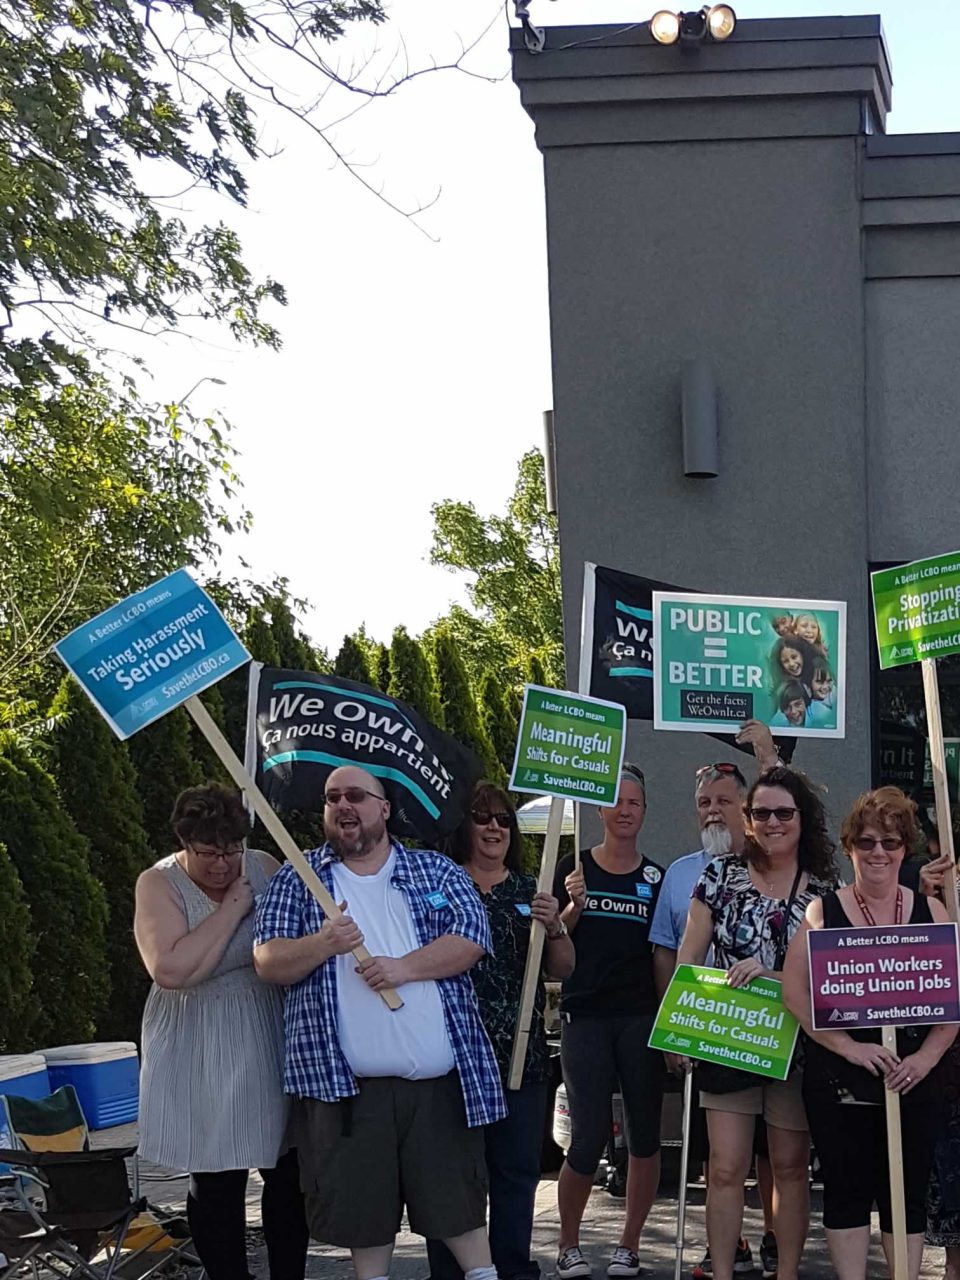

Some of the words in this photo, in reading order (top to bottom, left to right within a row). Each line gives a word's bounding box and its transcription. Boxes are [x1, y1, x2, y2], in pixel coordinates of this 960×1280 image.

[895, 577, 900, 585] A
[901, 572, 919, 584] Better
[920, 566, 940, 578] LCBO
[89, 633, 97, 644] A
[96, 619, 123, 638] Better
[122, 603, 146, 623] LCBO
[147, 590, 172, 609] means
[670, 608, 762, 636] PUBLIC
[87, 650, 136, 682] Taking
[132, 602, 208, 655] Harassment
[616, 617, 653, 650] W
[116, 626, 207, 691] Seriously
[612, 642, 634, 660] Ça
[162, 652, 230, 698] SavetheLCBO.ca
[669, 662, 763, 688] BETTER
[686, 692, 704, 704] Get
[706, 694, 721, 705] the
[724, 694, 747, 707] facts:
[688, 705, 746, 718] WeOwnIt.ca
[269, 694, 324, 723] We
[334, 702, 424, 753] Own
[564, 706, 584, 717] LCBO
[585, 712, 605, 722] means
[530, 722, 612, 754] Meaningful
[262, 729, 281, 752] Ça
[286, 723, 337, 740] nous
[341, 727, 451, 799] appartient
[527, 746, 547, 762] Shifts
[550, 750, 569, 766] for
[571, 755, 610, 774] Casuals
[543, 773, 605, 794] SavetheLCBO.ca
[601, 899, 635, 913] Own
[639, 905, 648, 917] It
[838, 938, 845, 946] A
[847, 937, 873, 946] Better
[876, 936, 899, 944] LCBO
[827, 960, 875, 976] Union
[879, 956, 943, 972] Workers
[697, 974, 703, 982] A
[704, 975, 727, 985] Better
[751, 986, 777, 998] means
[820, 980, 864, 996] doing
[868, 976, 914, 992] Union
[919, 974, 951, 992] Jobs
[677, 990, 784, 1030] Meaningful
[867, 1006, 944, 1020] SavetheLCBO.ca
[670, 1012, 706, 1030] Shifts
[708, 1020, 727, 1035] for
[730, 1027, 780, 1049] Casuals
[698, 1041, 772, 1069] SavetheLCBO.ca
